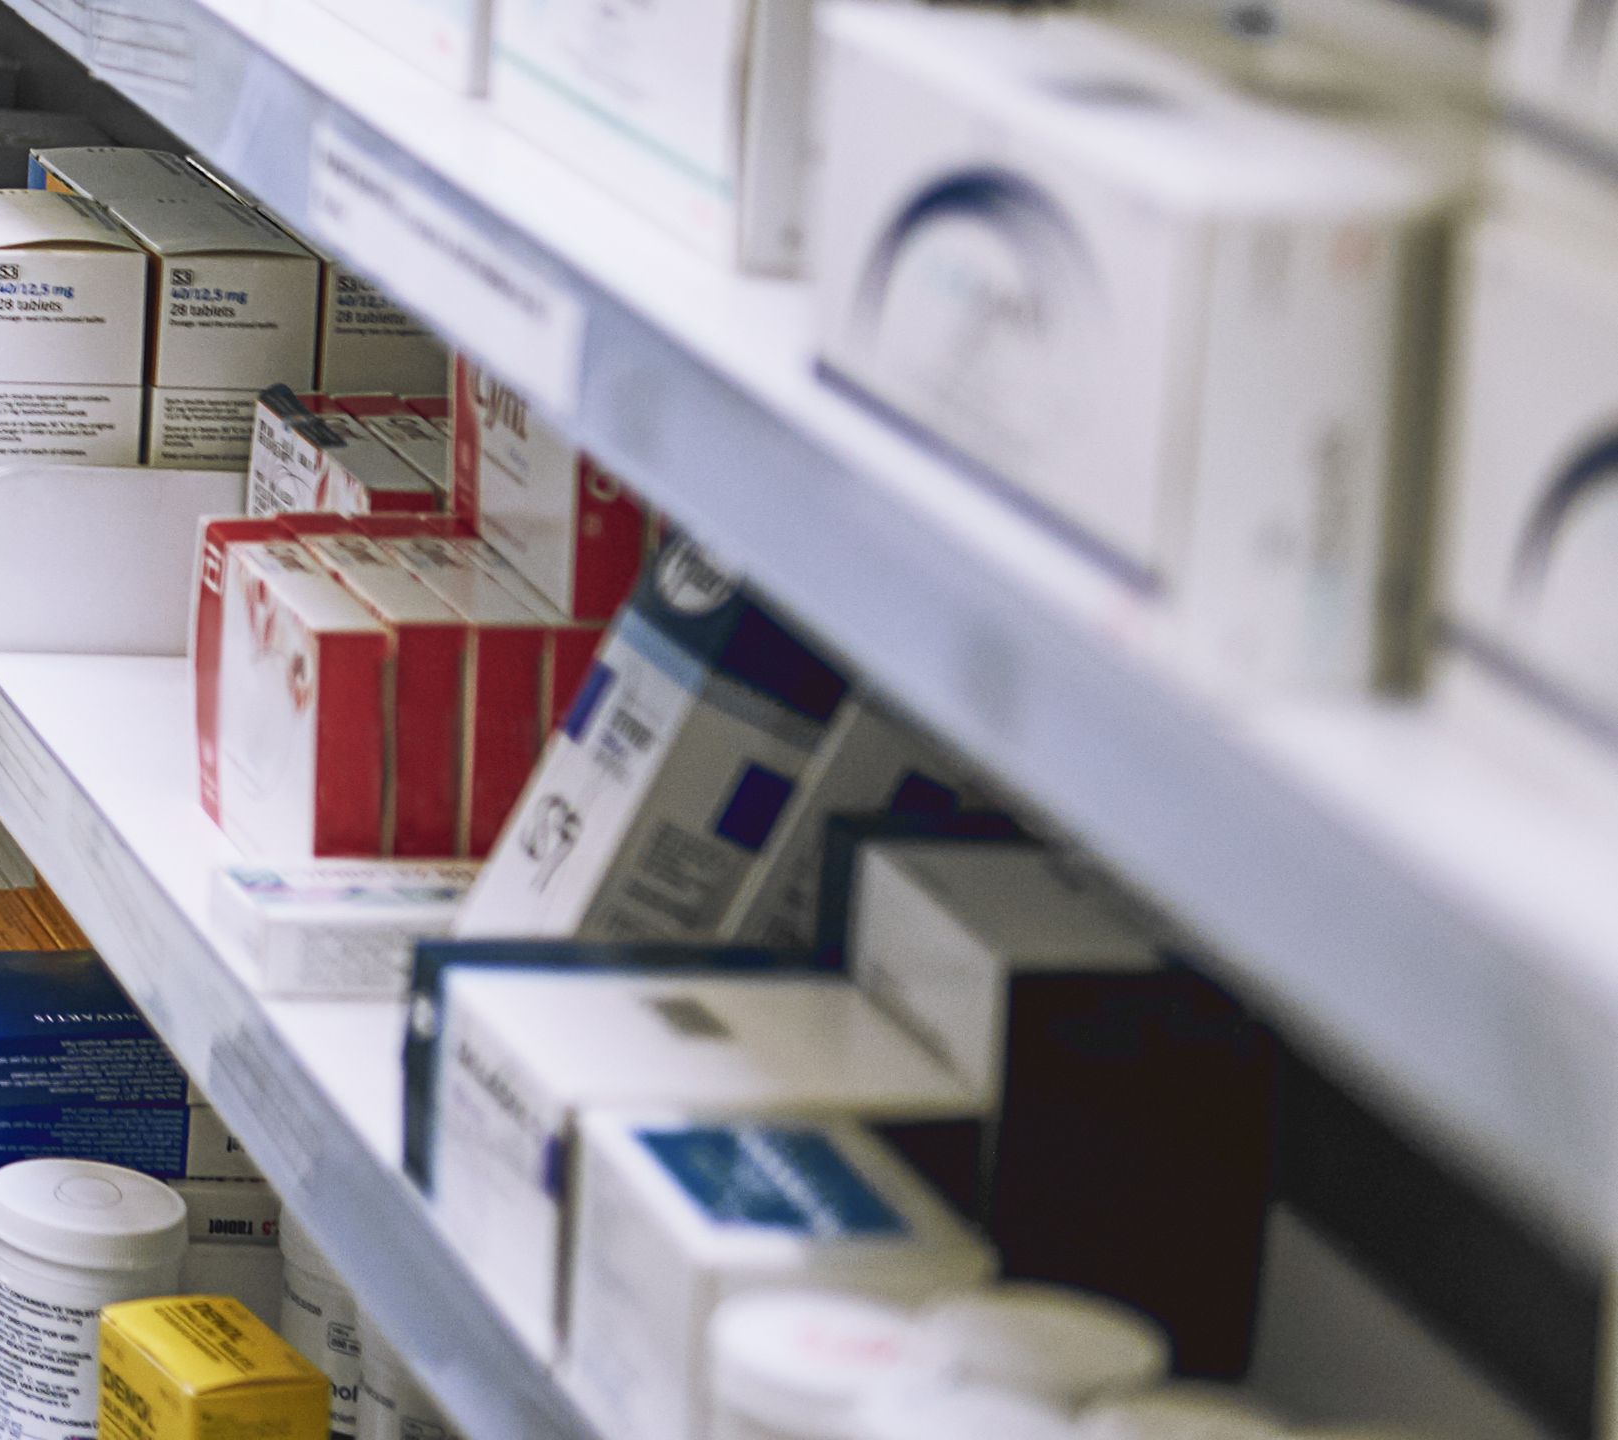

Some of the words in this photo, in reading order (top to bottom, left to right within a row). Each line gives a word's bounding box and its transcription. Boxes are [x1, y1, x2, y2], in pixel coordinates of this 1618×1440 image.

[0, 264, 19, 280] S3
[52, 285, 74, 298] mg
[225, 290, 248, 304] mg
[17, 298, 63, 312] tablets
[170, 303, 187, 315] 28
[189, 305, 236, 318] tablets
